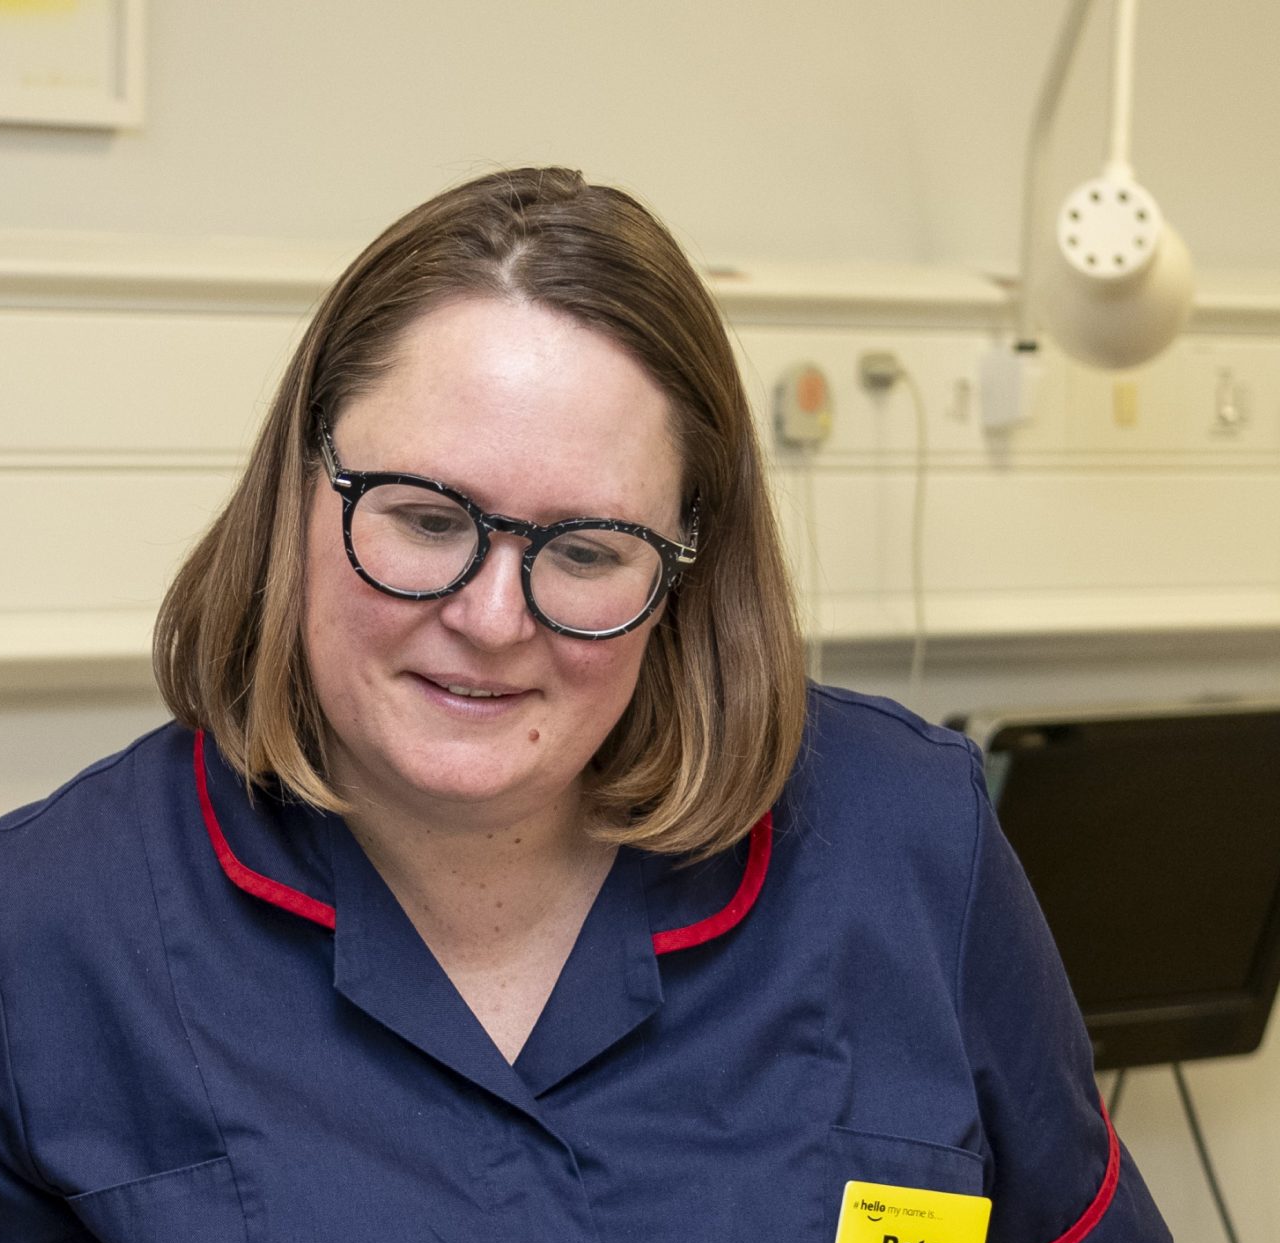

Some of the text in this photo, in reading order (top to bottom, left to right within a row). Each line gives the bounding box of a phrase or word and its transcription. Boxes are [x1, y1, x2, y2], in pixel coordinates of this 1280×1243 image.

[860, 1199, 886, 1212] hello
[887, 1206, 901, 1217] my
[902, 1207, 926, 1218] name
